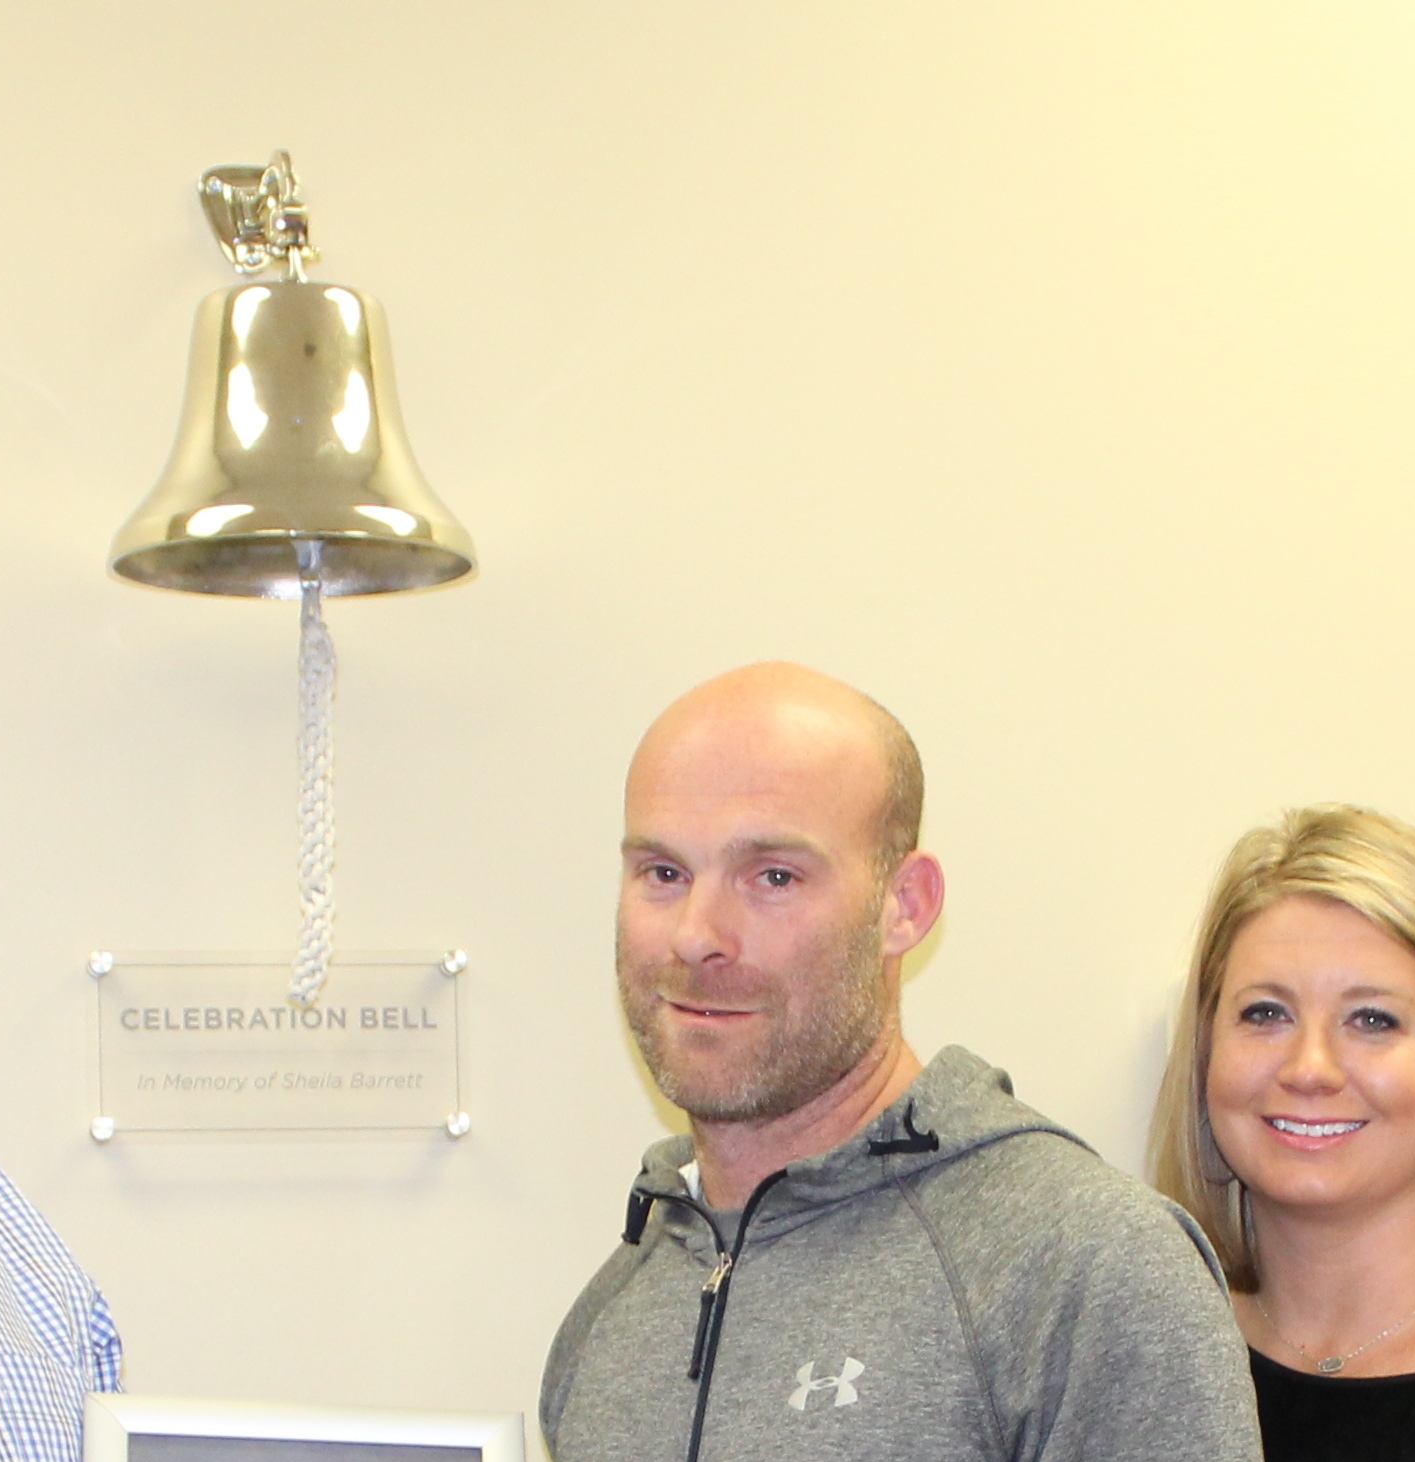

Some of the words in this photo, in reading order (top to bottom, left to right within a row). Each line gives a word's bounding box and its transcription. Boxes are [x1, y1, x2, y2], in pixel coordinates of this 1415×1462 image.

[120, 1006, 347, 1031] CELEBRATION
[360, 1006, 438, 1030] BELL
[137, 1073, 155, 1090] In
[163, 1072, 246, 1094] Memory
[254, 1071, 277, 1090] of
[283, 1072, 342, 1090] Sheila
[350, 1072, 423, 1090] Barrett
